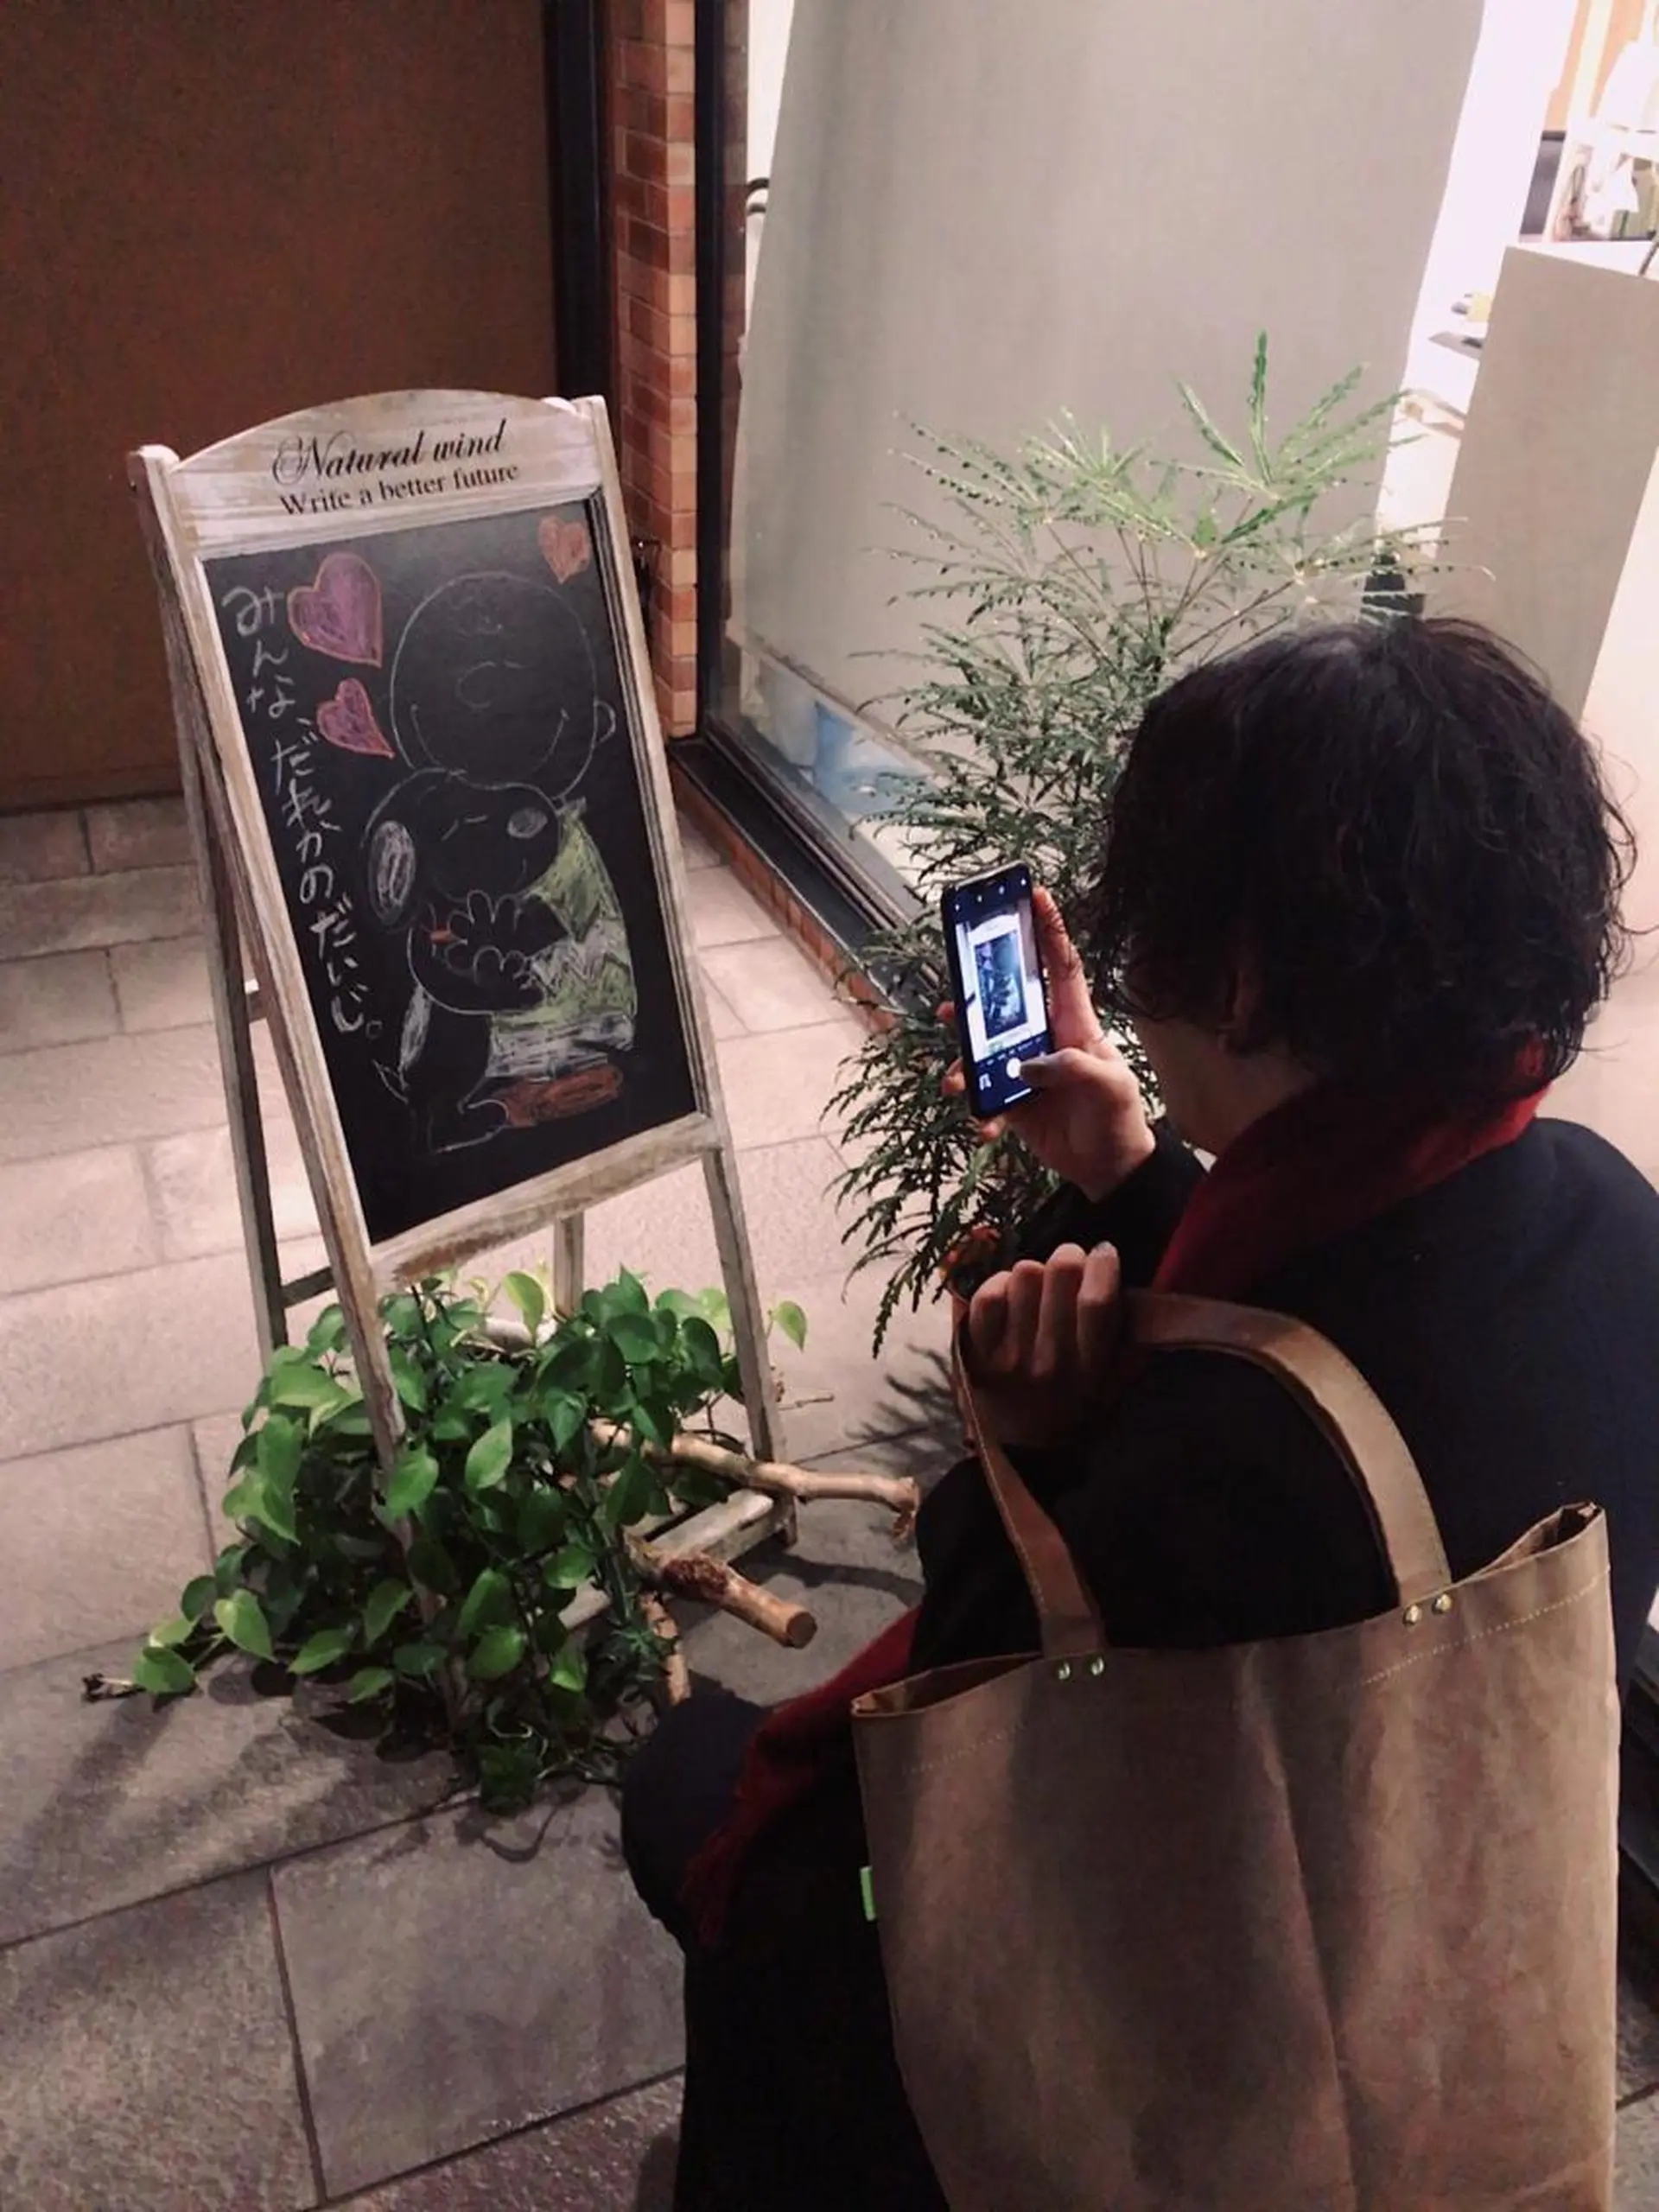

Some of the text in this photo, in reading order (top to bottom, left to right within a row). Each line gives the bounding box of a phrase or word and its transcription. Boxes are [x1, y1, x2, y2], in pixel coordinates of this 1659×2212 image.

[271, 418, 507, 486] Natural wind
[280, 466, 520, 516] Write a better future
